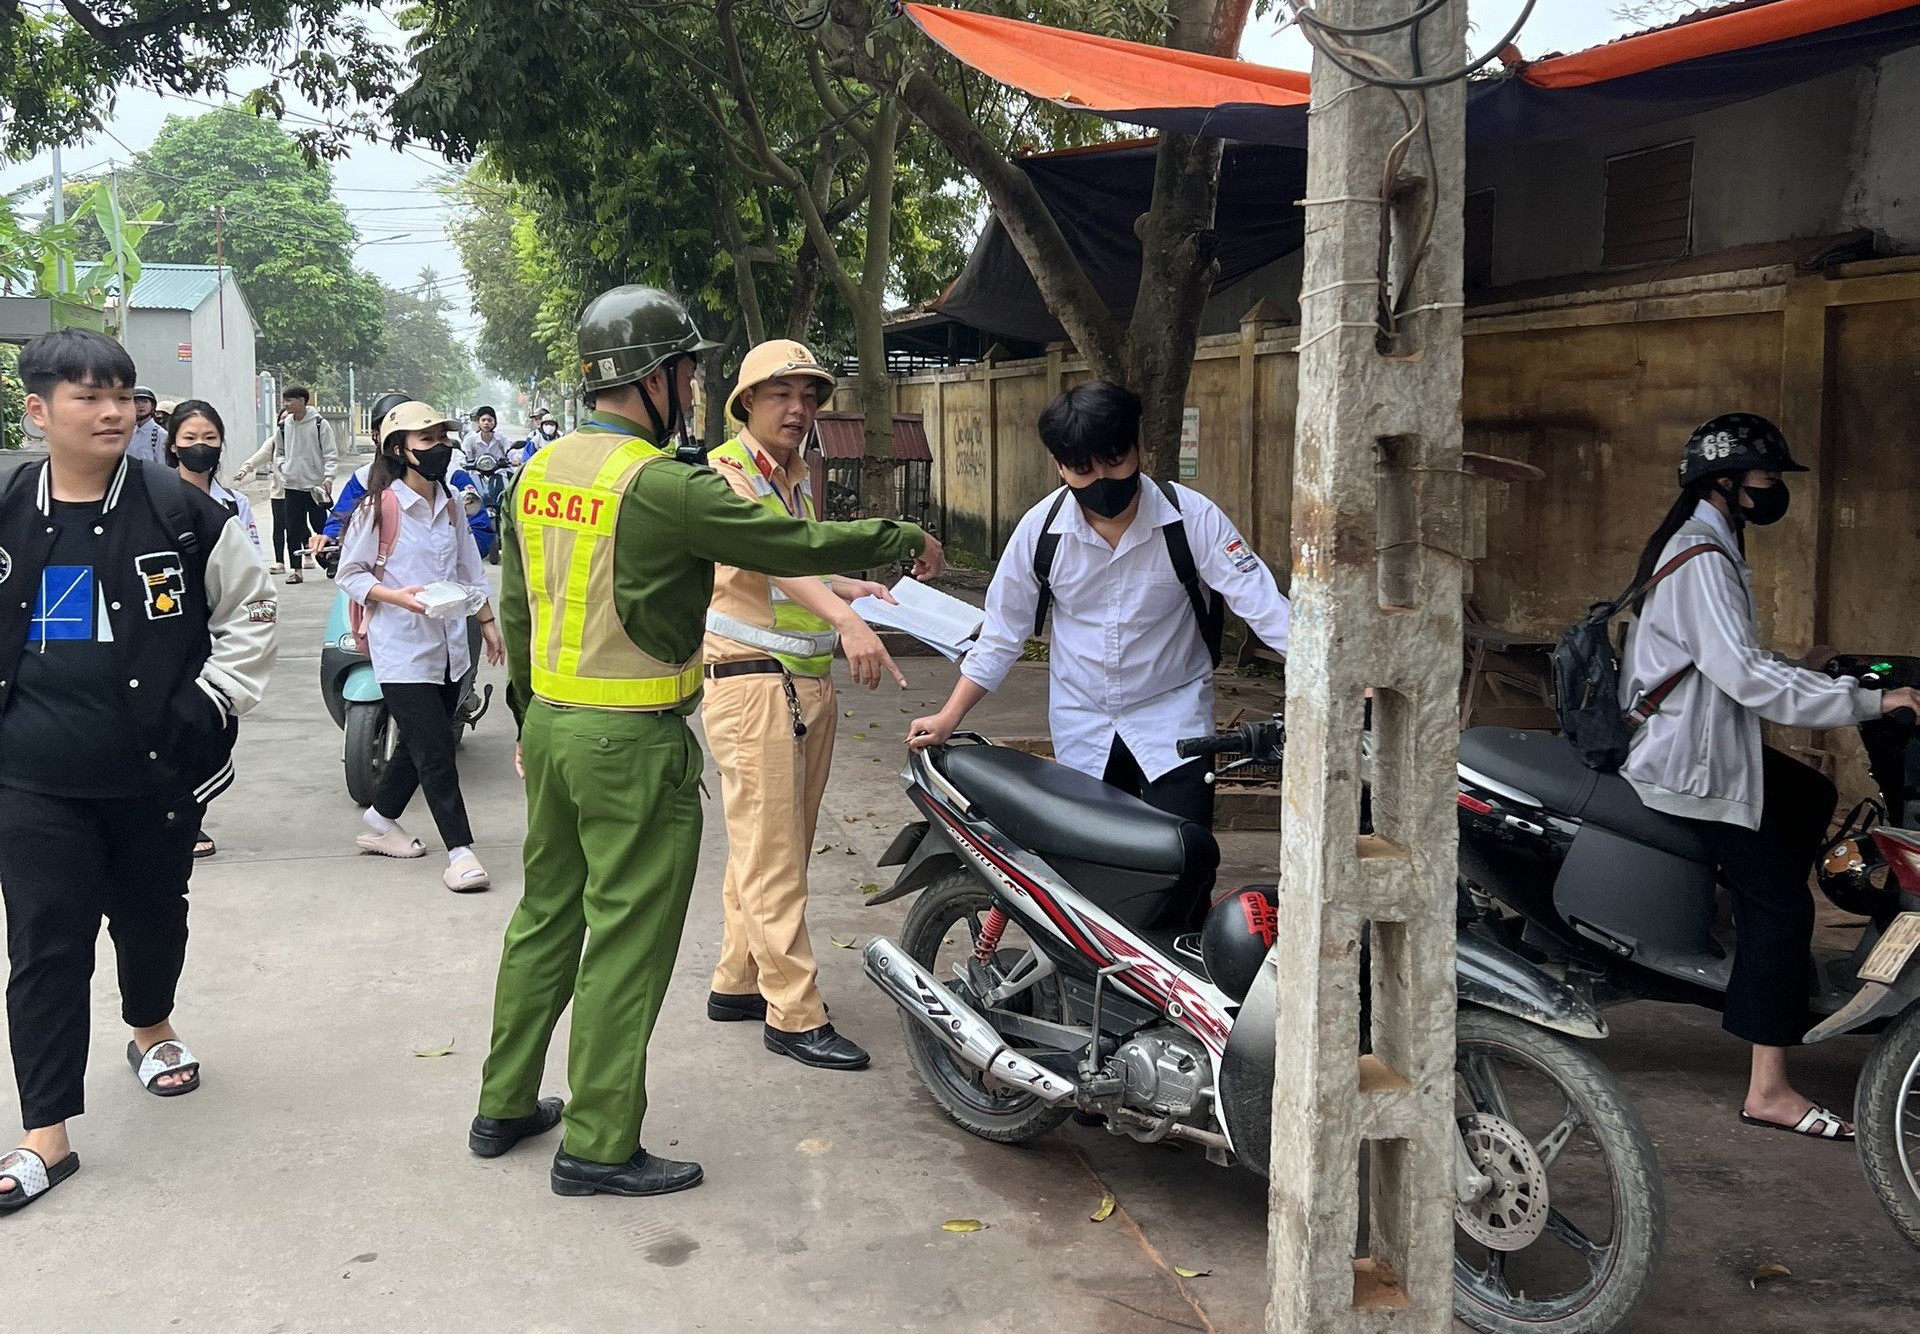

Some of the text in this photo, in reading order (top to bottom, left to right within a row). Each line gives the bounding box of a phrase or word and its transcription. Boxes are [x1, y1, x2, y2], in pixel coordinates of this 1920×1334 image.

[523, 488, 604, 525] C.S.G.T
[135, 551, 186, 620] F
[946, 827, 1003, 878] SIRIUS
[1247, 896, 1264, 926] DEAD
